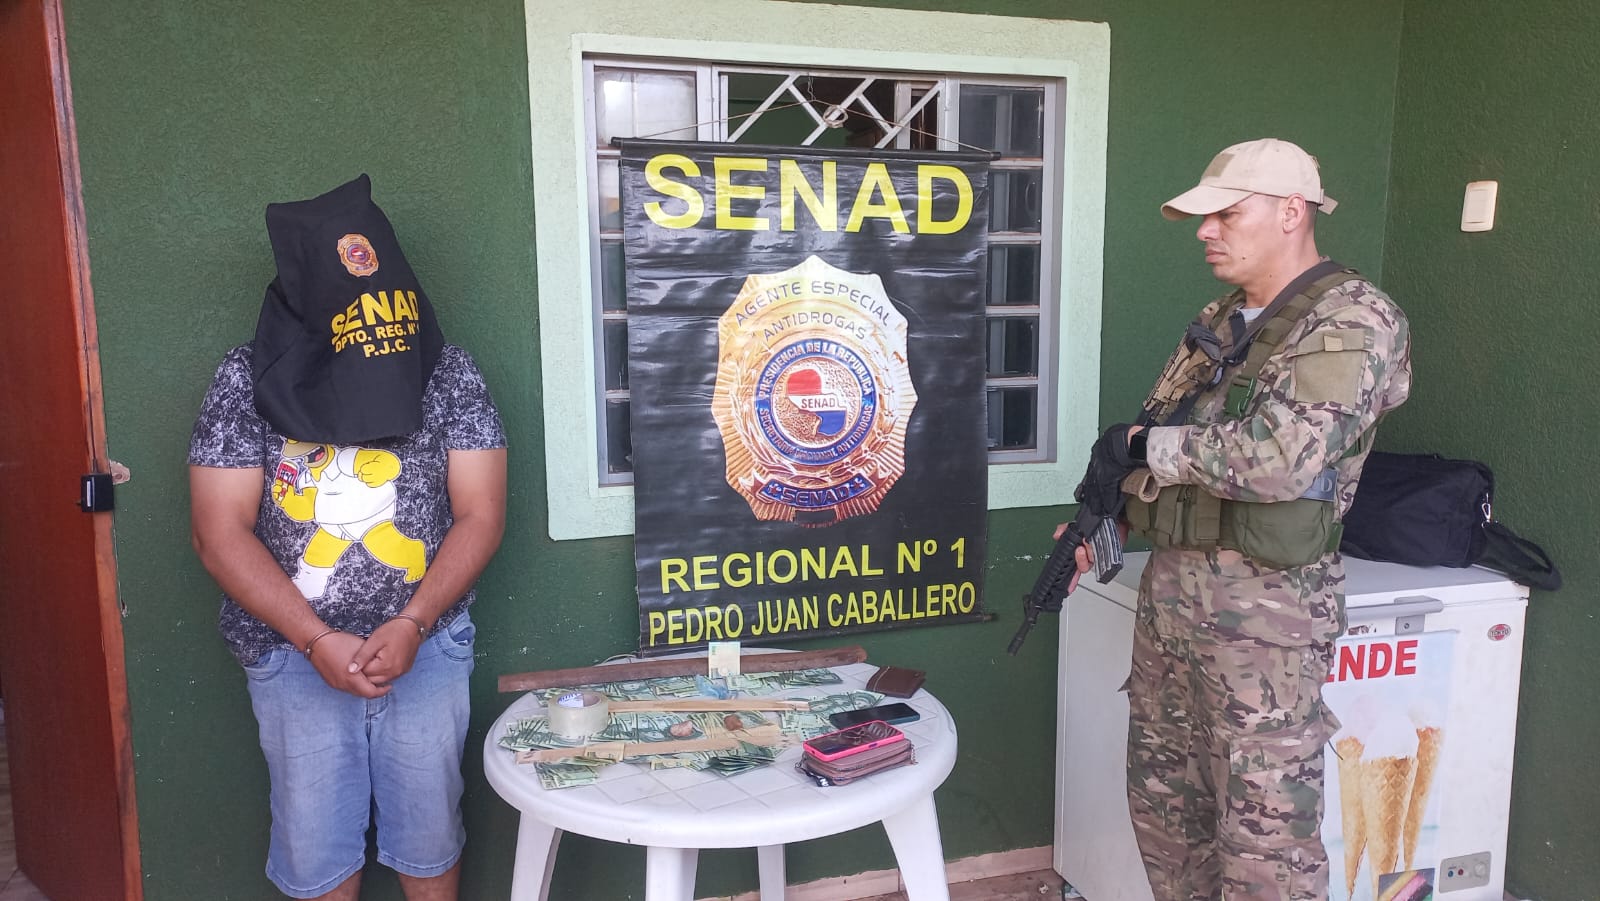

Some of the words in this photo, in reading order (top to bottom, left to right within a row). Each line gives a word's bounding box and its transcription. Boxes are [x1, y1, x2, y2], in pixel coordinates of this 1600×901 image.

[643, 153, 974, 235] SENAD
[331, 289, 419, 345] SENAD
[735, 281, 802, 327] AGENTE
[811, 280, 893, 327] ESPECIAL
[335, 329, 372, 353] DPTO.
[374, 323, 407, 339] REG.
[363, 338, 411, 358] P.J.C.
[763, 311, 868, 342] ANTIDROGAS
[758, 344, 806, 398] PRESIDENCIA
[806, 342, 820, 353] DE
[822, 342, 837, 355] LA
[837, 348, 874, 395] REPUBLICA
[801, 398, 836, 409] SENAD
[781, 483, 851, 506] SENAD
[660, 543, 884, 595] REGIONAL
[949, 536, 966, 569] 1
[648, 602, 744, 648] PEDRO
[750, 595, 820, 636] JUAN
[826, 580, 977, 627] CABALLERO
[1327, 639, 1419, 682] NDE
